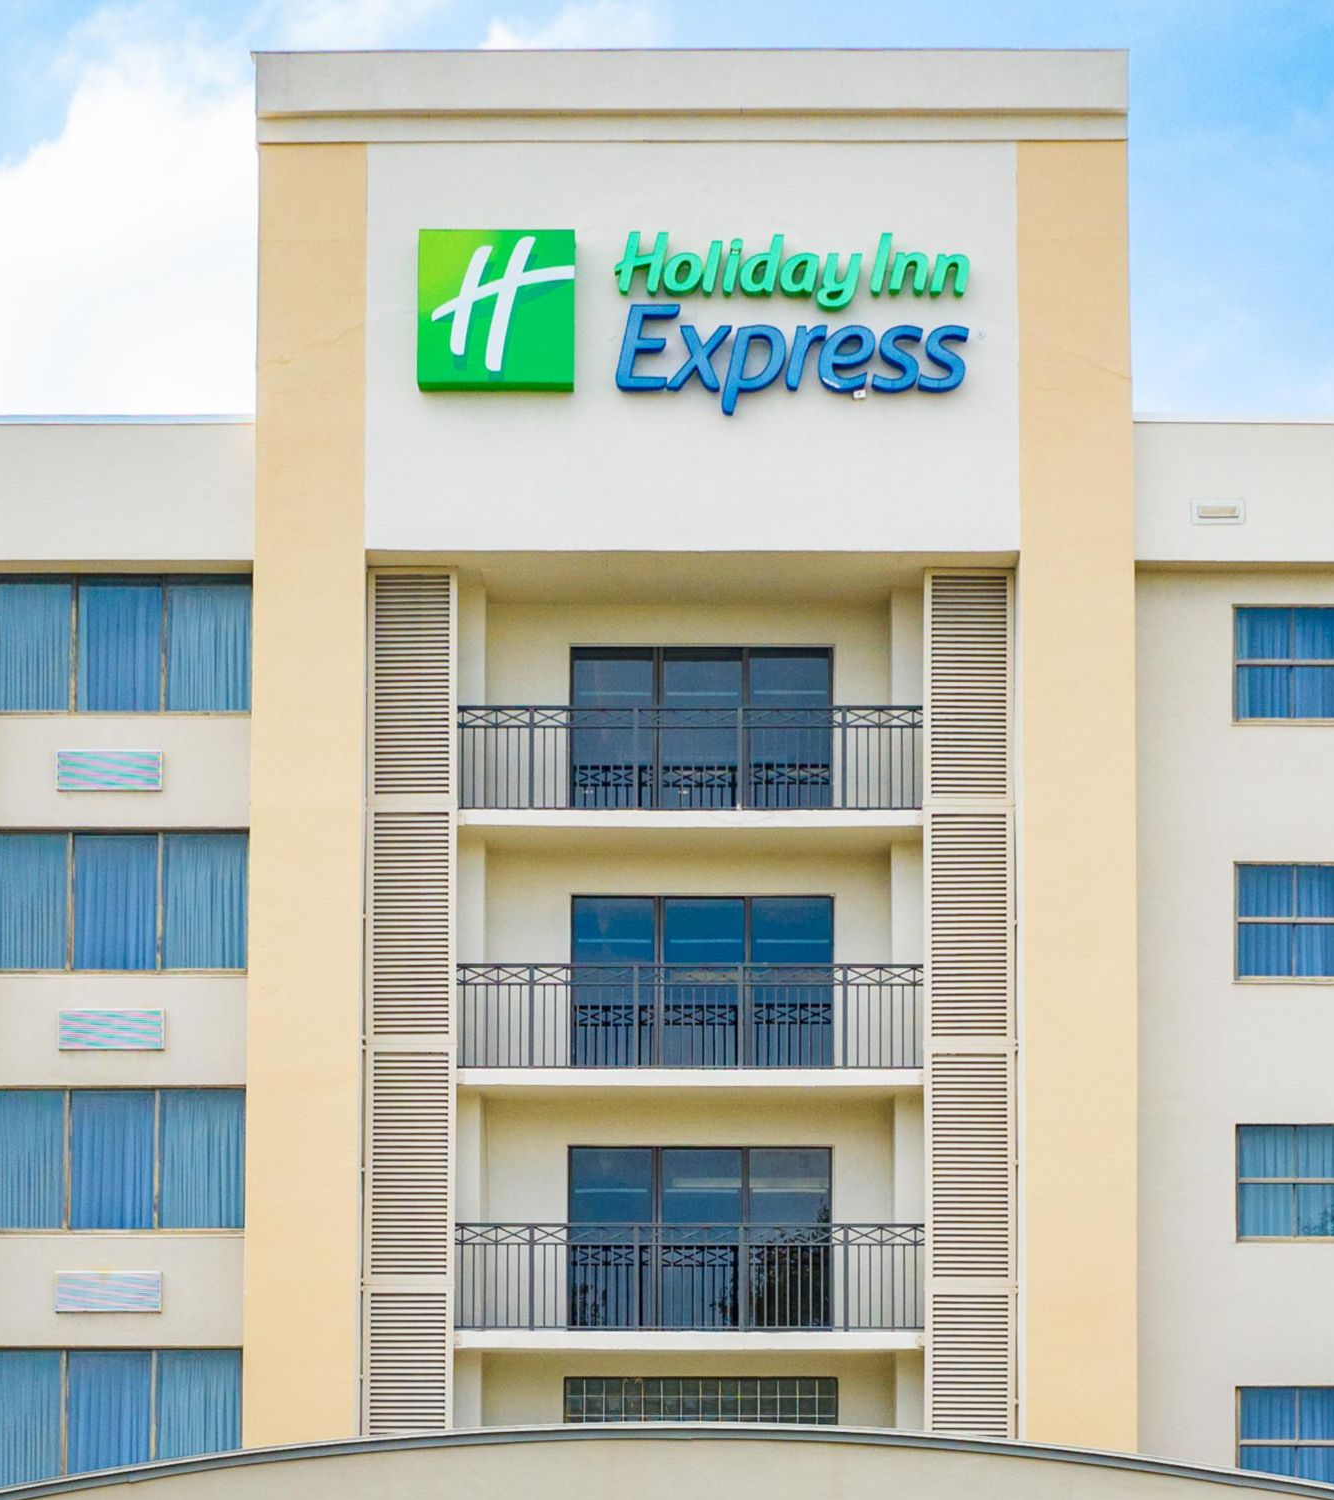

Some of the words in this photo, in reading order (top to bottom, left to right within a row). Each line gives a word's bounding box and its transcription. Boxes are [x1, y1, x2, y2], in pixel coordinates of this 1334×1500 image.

[614, 231, 862, 312] Holiday
[870, 232, 970, 298] Inn
[615, 304, 970, 416] Express
